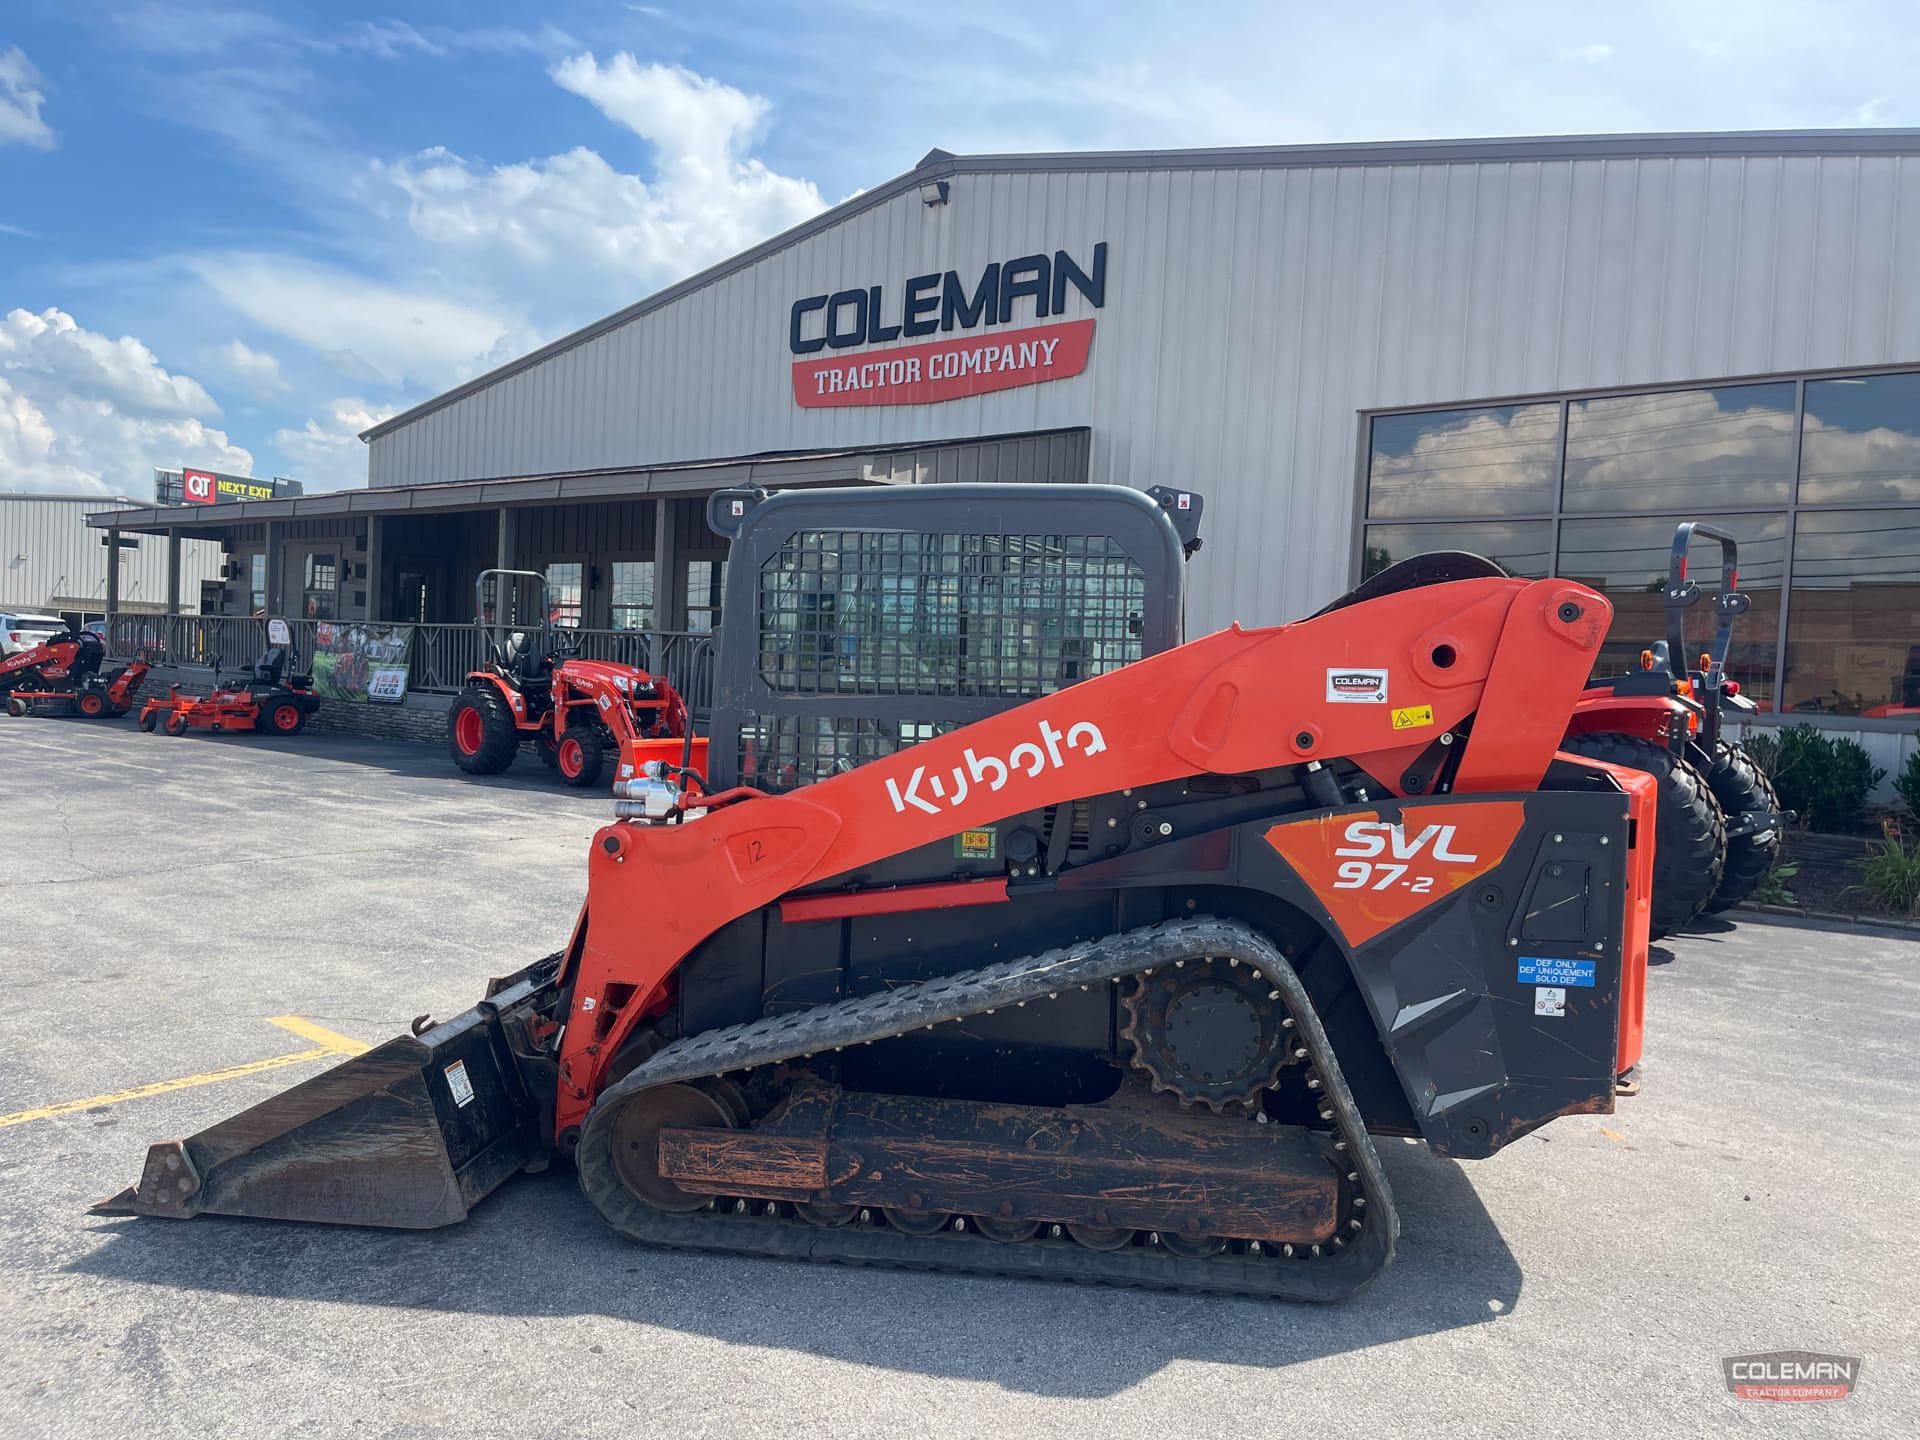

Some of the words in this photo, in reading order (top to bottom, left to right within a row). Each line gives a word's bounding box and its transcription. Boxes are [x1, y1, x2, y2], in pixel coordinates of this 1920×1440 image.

[790, 241, 1107, 354] COLEMAN
[814, 358, 922, 394] TRACTOR
[928, 338, 1060, 380] COMPANY
[188, 475, 211, 498] QT
[218, 480, 247, 495] NEXT
[248, 485, 272, 499] EXIT
[1335, 677, 1379, 686] COLEMAN
[885, 720, 1107, 814] Kubota
[1334, 821, 1478, 863] SVL
[1333, 861, 1434, 893] 97-2
[1519, 966, 1536, 974] DEF
[1538, 967, 1593, 977] UNIQUEMENT
[1555, 960, 1578, 969] ONLY
[1535, 975, 1558, 983] SOLO
[1560, 976, 1577, 984] DEF
